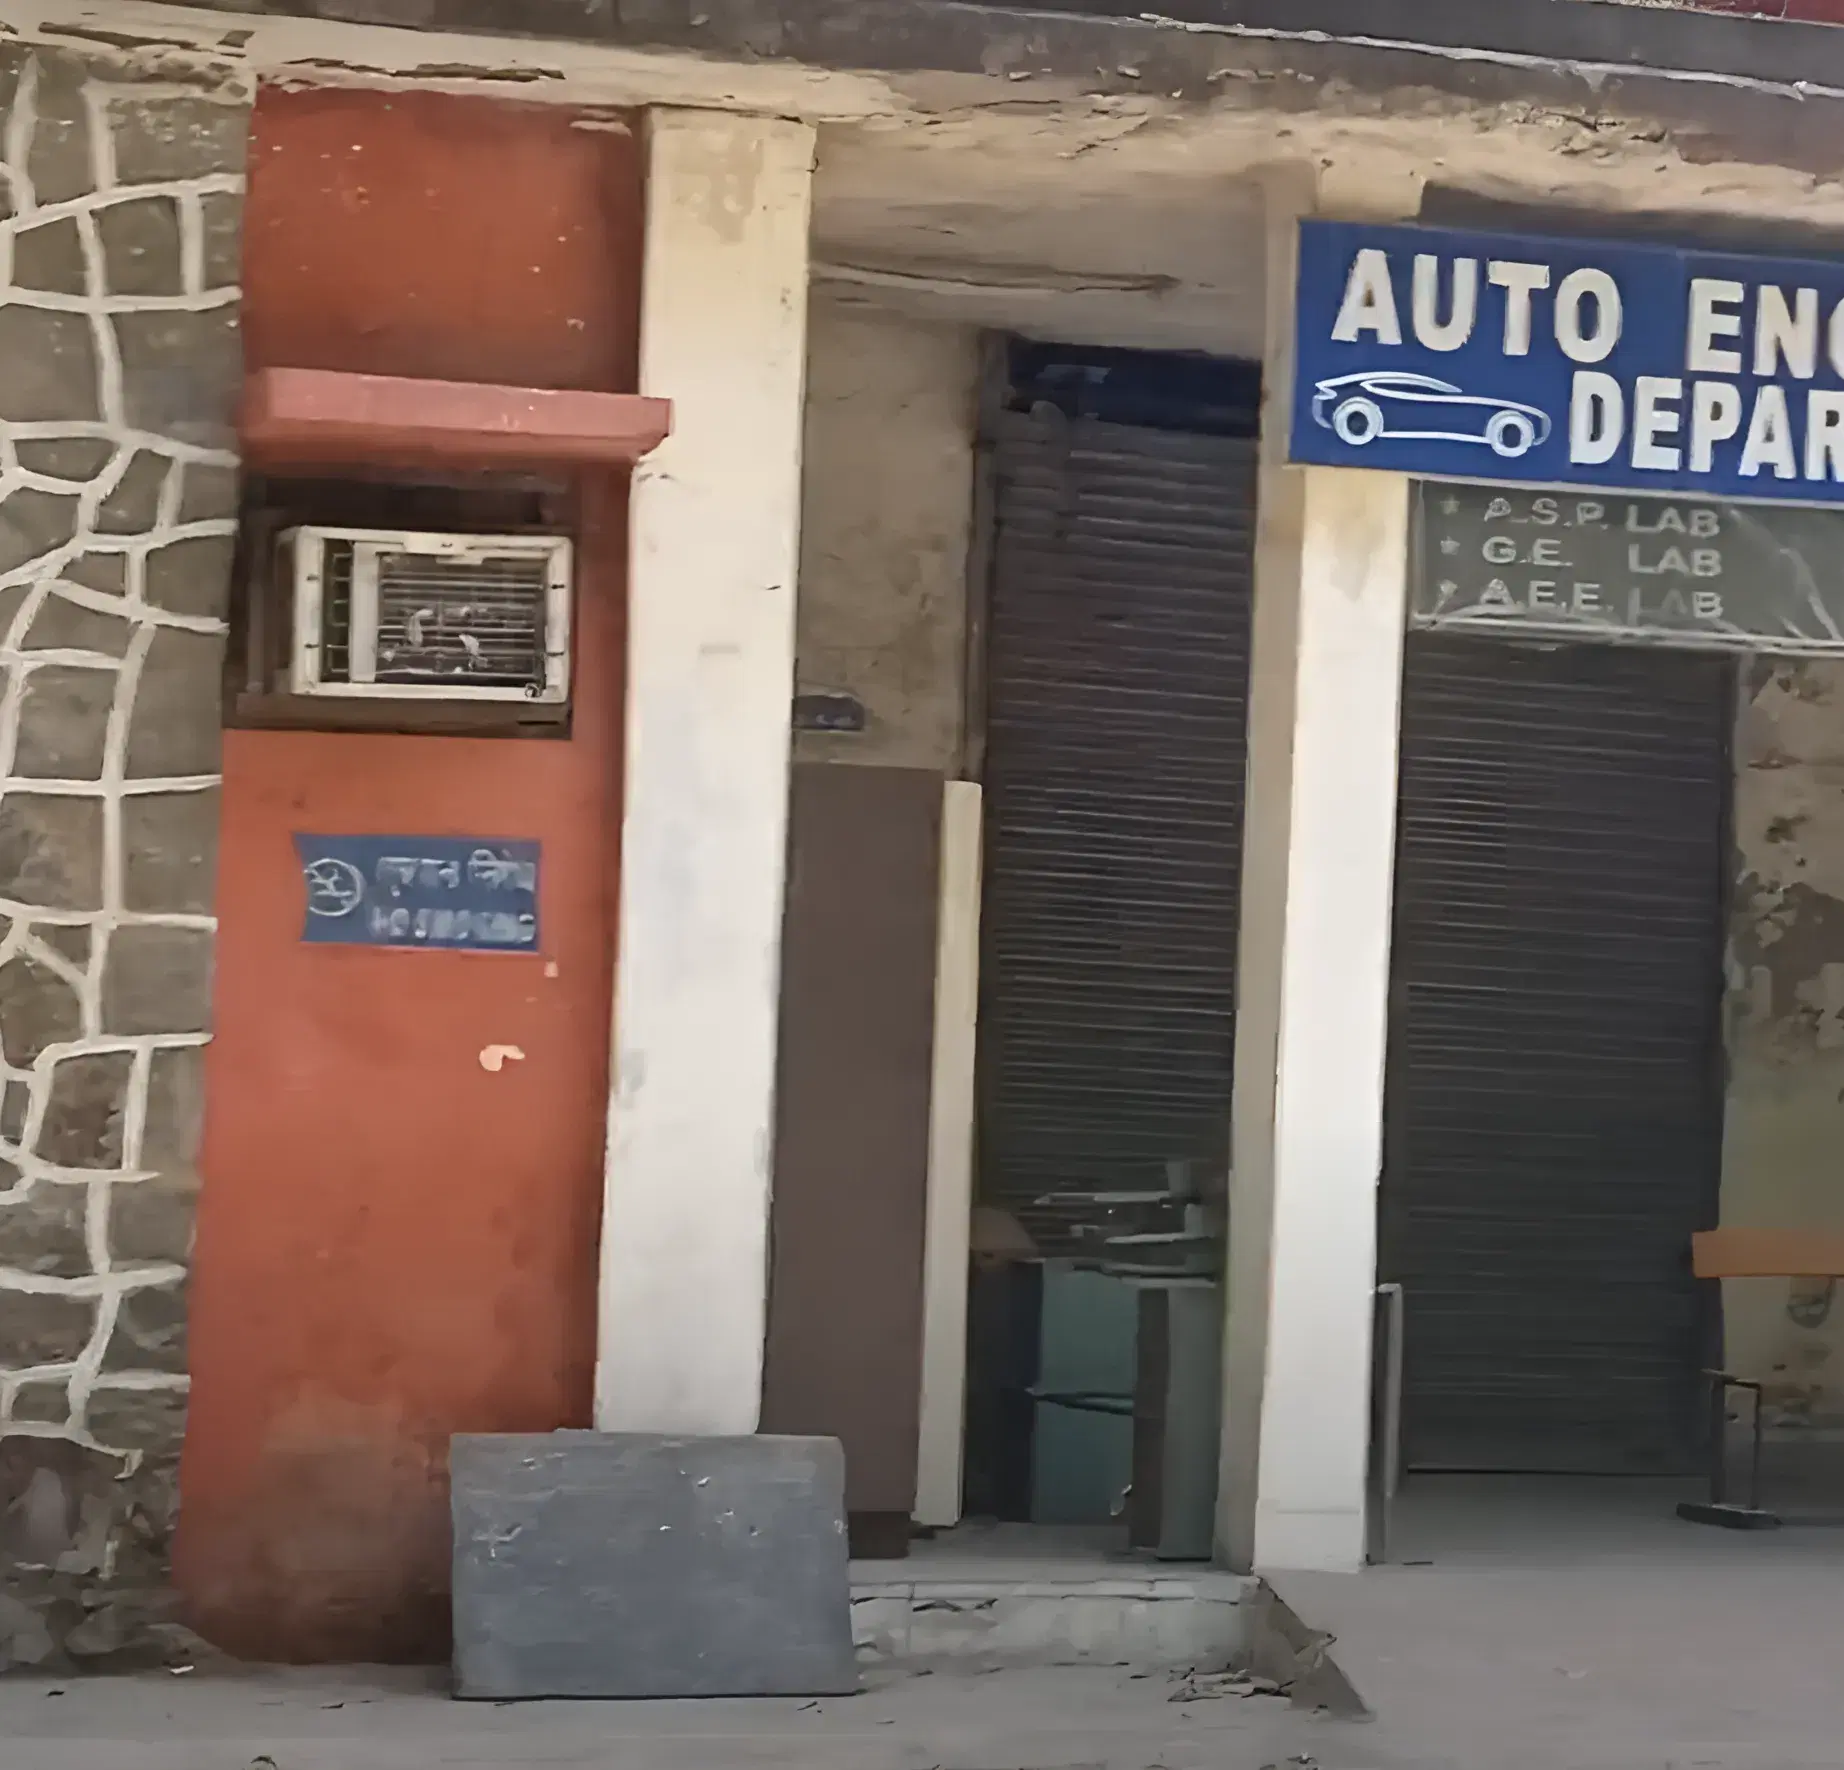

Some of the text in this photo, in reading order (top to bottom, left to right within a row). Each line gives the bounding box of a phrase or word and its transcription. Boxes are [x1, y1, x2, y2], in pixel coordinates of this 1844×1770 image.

[1331, 248, 1622, 363] AUTO
[1625, 504, 1721, 538] LAB
[1482, 536, 1722, 577] G.E. LAB
